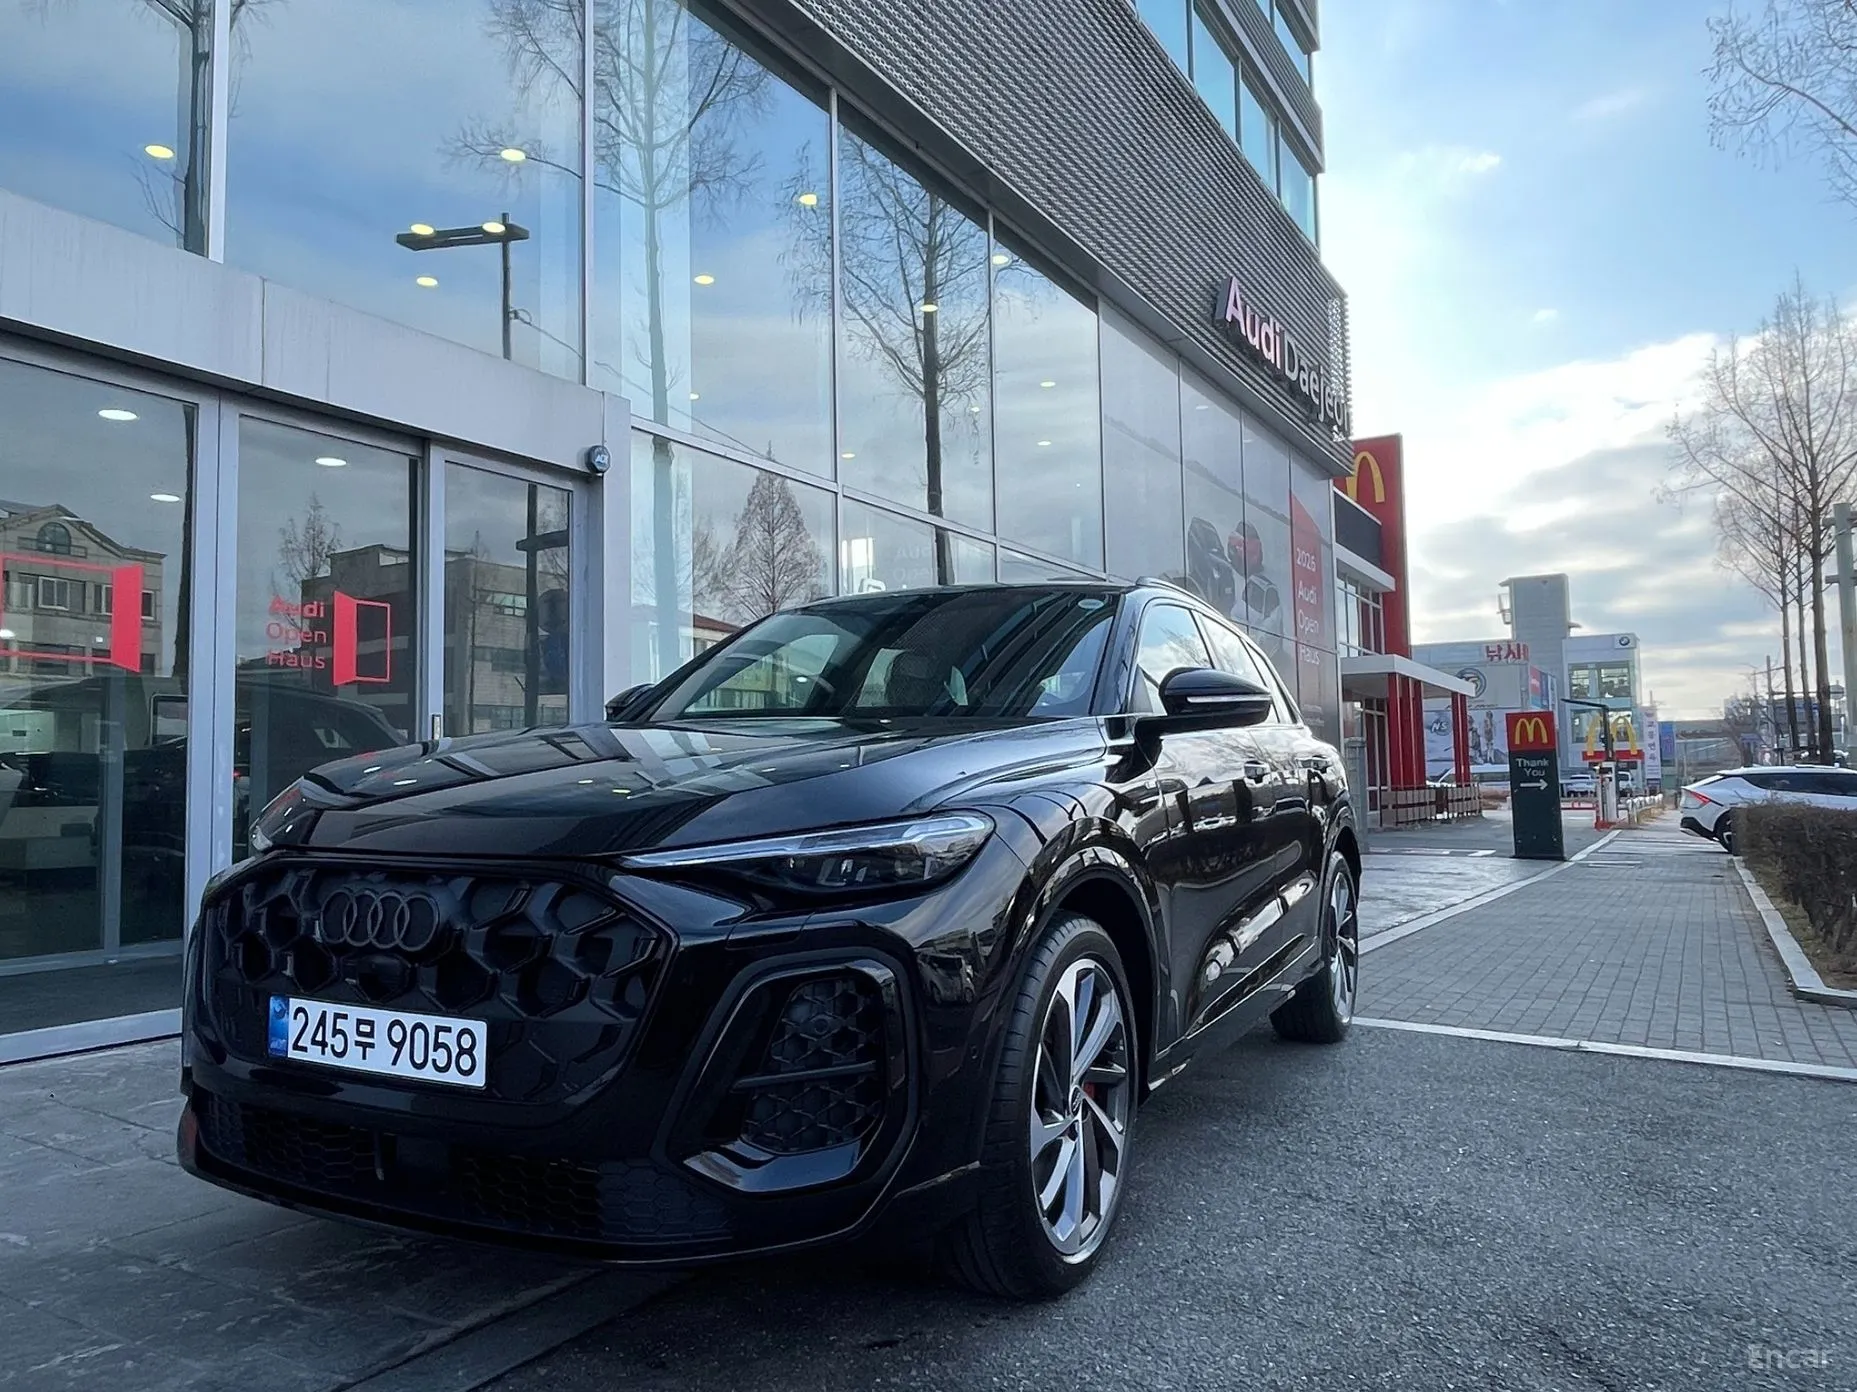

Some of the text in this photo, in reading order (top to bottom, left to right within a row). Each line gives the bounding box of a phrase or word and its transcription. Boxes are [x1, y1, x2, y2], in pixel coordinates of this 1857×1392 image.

[1225, 276, 1281, 370] Audi
[1296, 547, 1317, 572] 2026
[1298, 580, 1318, 605] Audi
[268, 595, 325, 618] Audi
[266, 622, 327, 645] Open
[1298, 608, 1320, 636] Open
[267, 649, 326, 669] Haus
[1516, 758, 1549, 767] Thank
[1524, 768, 1545, 777] You
[291, 1006, 477, 1077] 245무 9058
